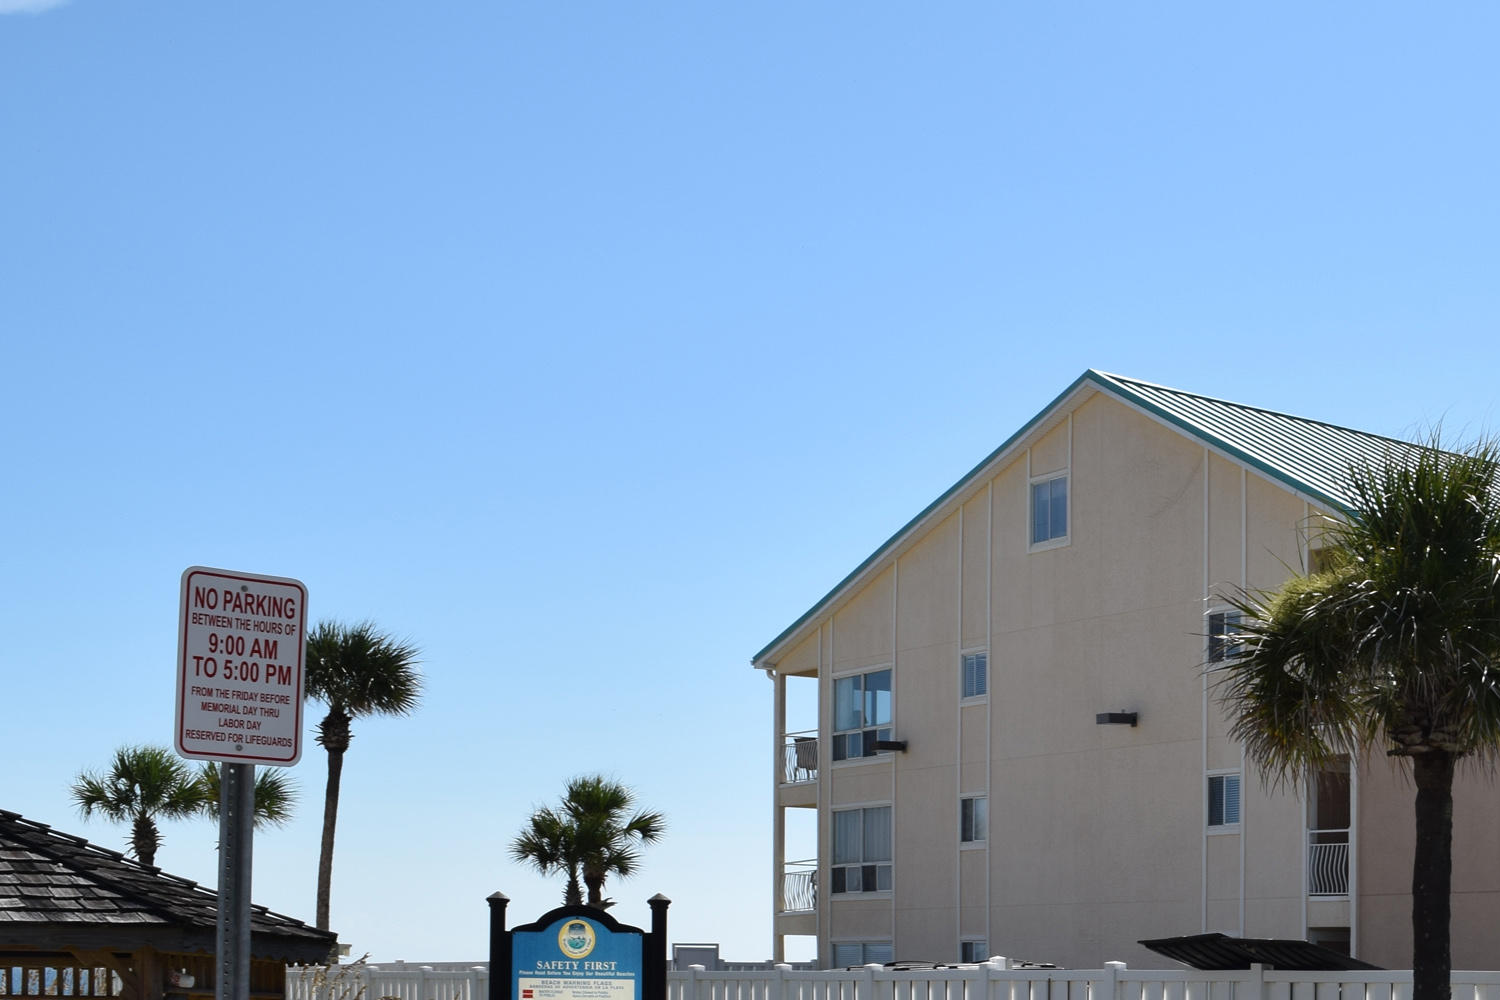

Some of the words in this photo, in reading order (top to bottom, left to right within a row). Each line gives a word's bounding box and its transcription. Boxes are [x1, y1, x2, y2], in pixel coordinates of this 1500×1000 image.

[195, 586, 218, 609] NO
[224, 590, 295, 619] PARKING
[192, 613, 232, 628] BETWEEN
[235, 618, 251, 630] THE
[254, 621, 282, 634] HOURS
[285, 624, 296, 636] OF
[209, 633, 245, 656] 9:00
[250, 639, 278, 660] AM
[193, 656, 217, 677] TO
[224, 660, 258, 682] 5:00
[266, 664, 291, 685] PM
[191, 686, 213, 696] FROM
[216, 689, 230, 698] THE
[232, 690, 258, 701] FRIDAY
[261, 693, 290, 704] BEFORE
[201, 702, 240, 714] MEMORIAL
[243, 706, 257, 716] DAY
[260, 708, 279, 718] THRU
[219, 718, 244, 729] LABOR
[247, 721, 261, 730] DAY
[186, 729, 226, 741] RESERVED
[228, 733, 243, 743] FOR
[245, 735, 293, 747] LIFEGUARDS
[537, 961, 579, 969] SAFETY
[584, 961, 616, 970] FIRST
